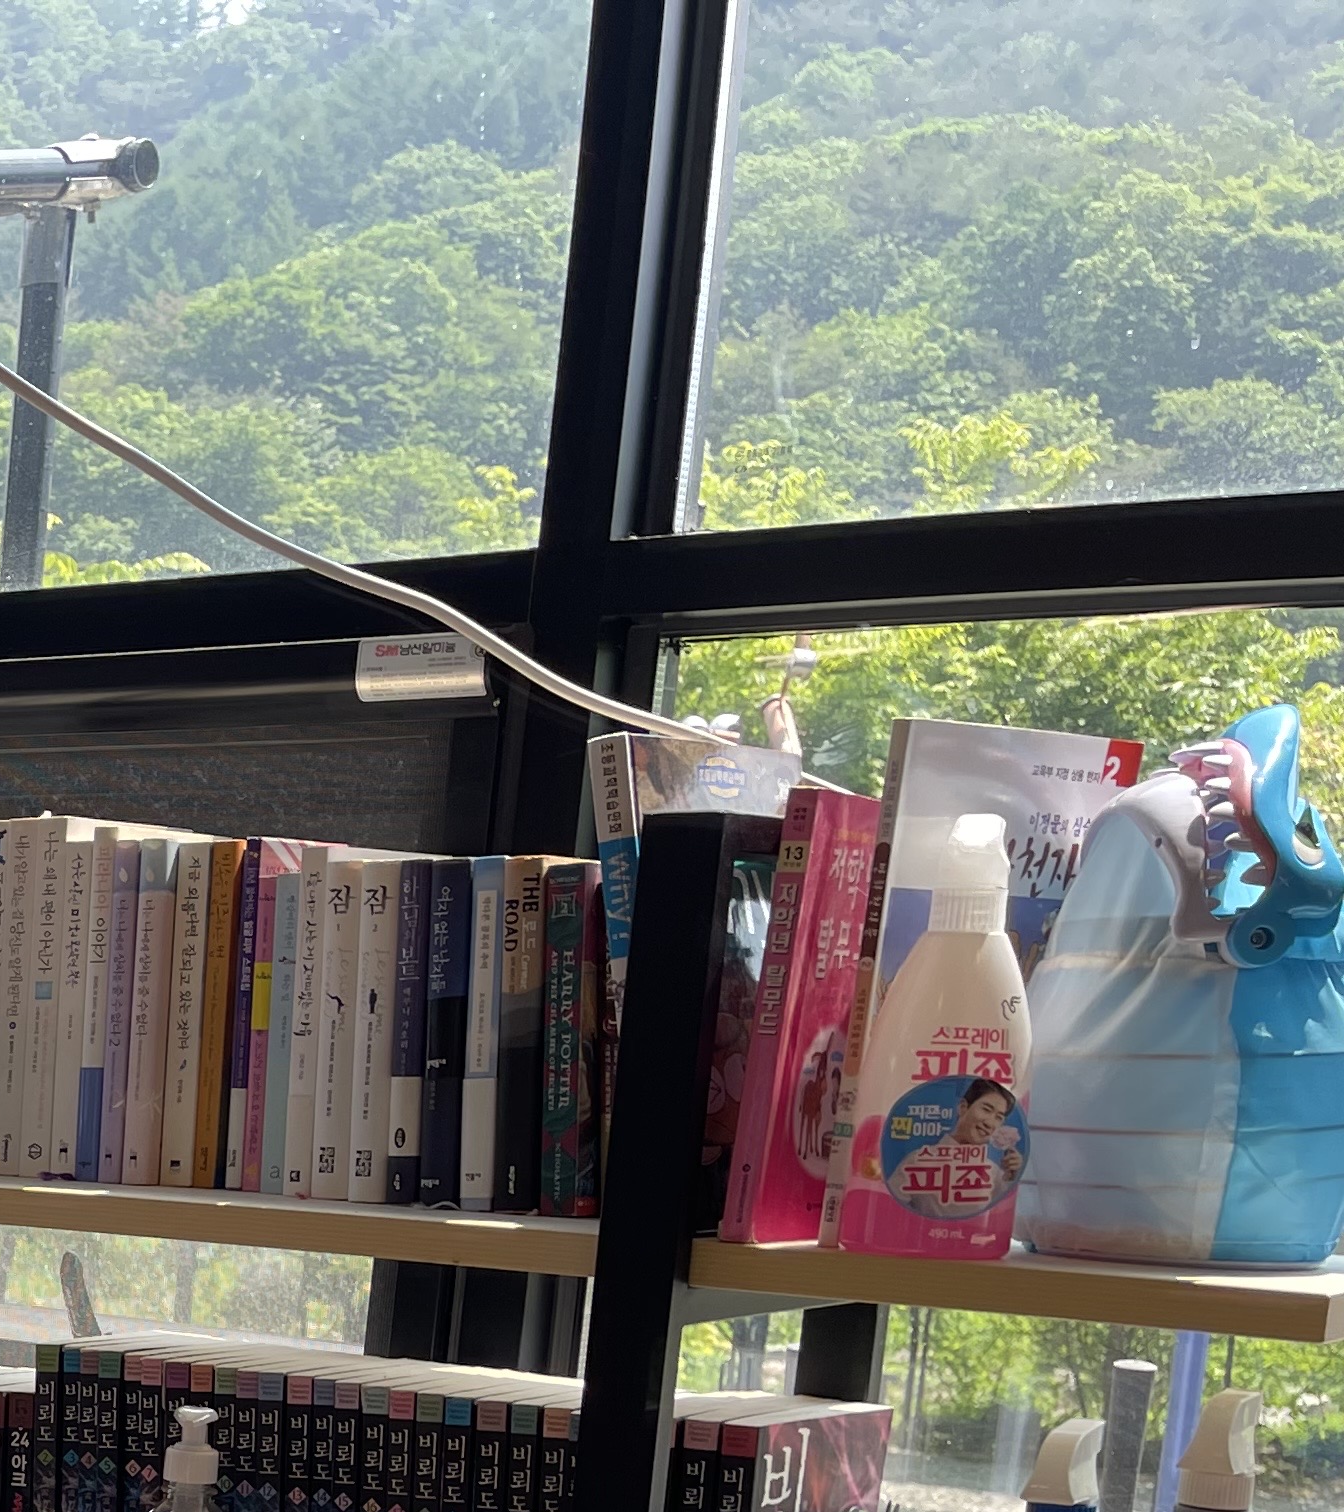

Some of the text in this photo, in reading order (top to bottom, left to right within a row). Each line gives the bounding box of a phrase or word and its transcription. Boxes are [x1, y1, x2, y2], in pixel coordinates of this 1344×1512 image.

[1102, 756, 1121, 784] 2
[363, 885, 392, 916] 잠
[505, 873, 540, 953] THE ROAD
[90, 917, 108, 965] 이야기
[430, 886, 454, 993] 여자 없는 남자들
[758, 882, 799, 1035] 저학년 탈무드
[558, 950, 574, 1109] HARRY POTTER
[930, 1026, 1008, 1050] 스프레이
[907, 1104, 952, 1120] 피죤이
[917, 1146, 985, 1163] 스프레이
[902, 1164, 992, 1204] 피죤
[929, 1229, 949, 1239] 490
[37, 1381, 55, 1442] 비뢰도
[98, 1387, 117, 1449] 비뢰도
[11, 1431, 30, 1447] 24
[288, 1414, 308, 1479] 비뢰도
